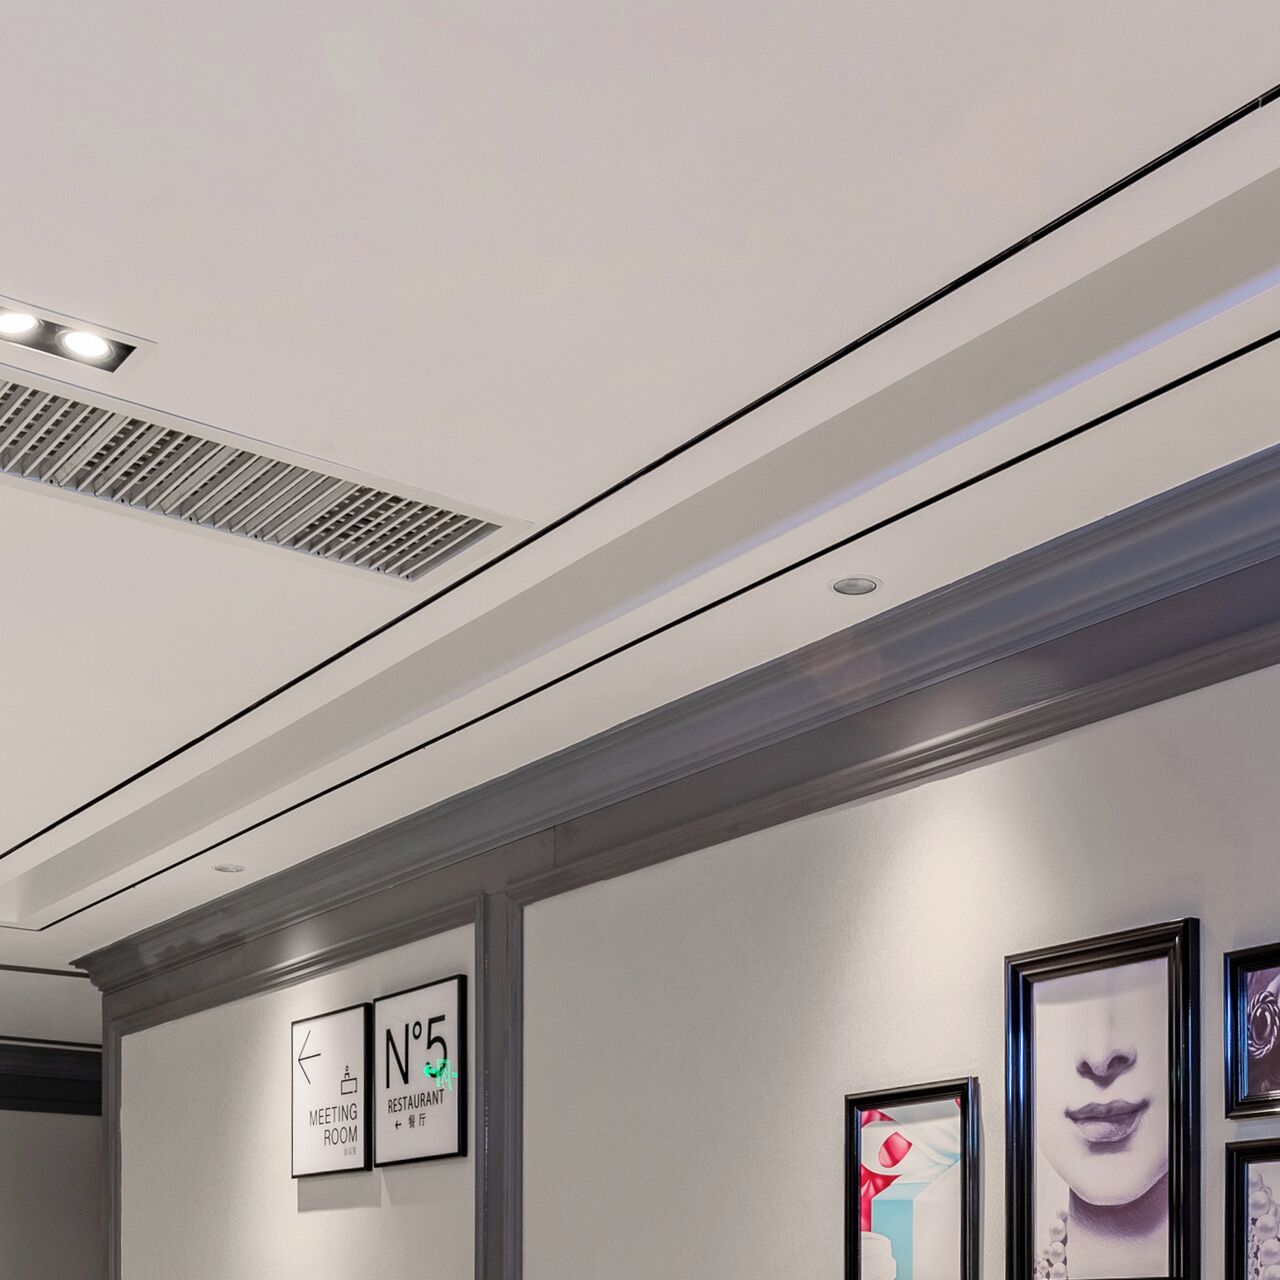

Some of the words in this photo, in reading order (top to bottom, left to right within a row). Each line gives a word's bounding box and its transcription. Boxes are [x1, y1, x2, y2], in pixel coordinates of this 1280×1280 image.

[387, 1089, 445, 1114] RESTAURANT
[309, 1102, 358, 1126] MEETING
[323, 1125, 358, 1146] ROOM
